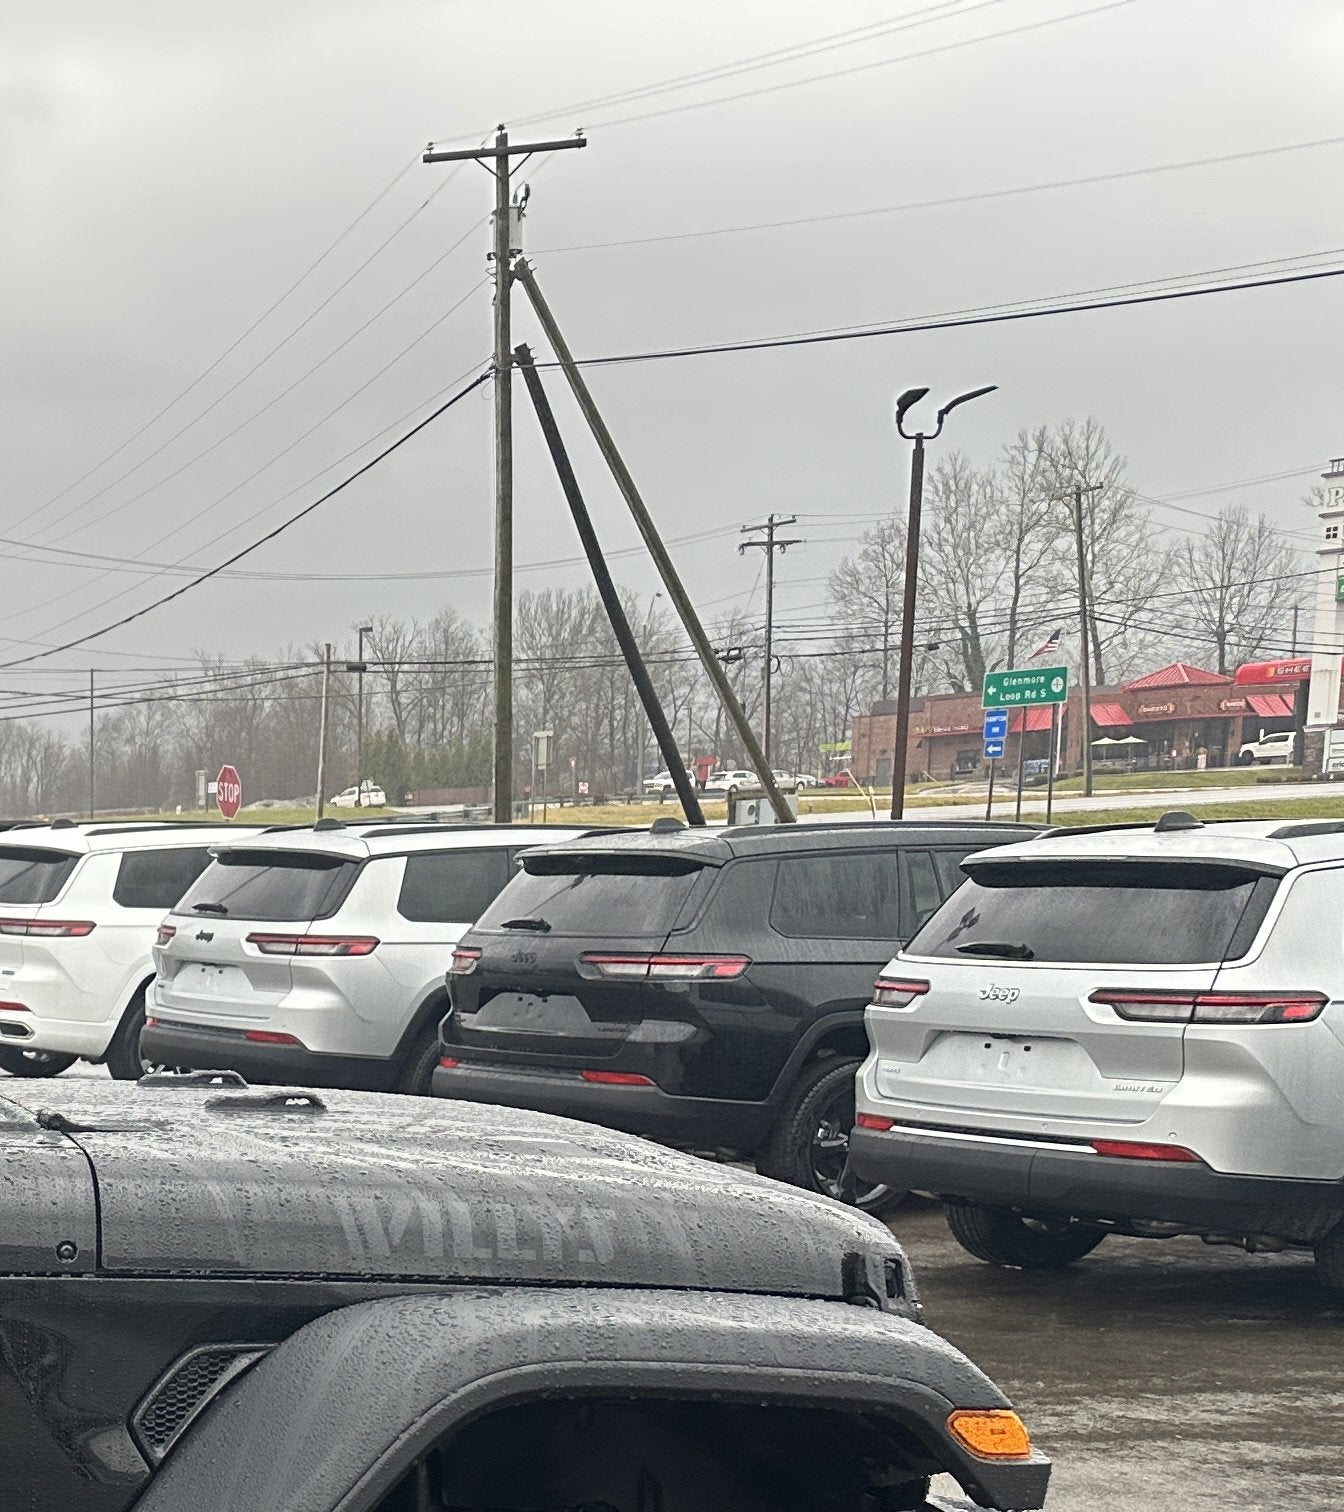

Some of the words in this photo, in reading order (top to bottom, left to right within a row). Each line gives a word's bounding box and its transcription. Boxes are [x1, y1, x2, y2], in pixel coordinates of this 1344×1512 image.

[1002, 675, 1046, 687] Glenmore
[999, 691, 1021, 701] Loop
[1024, 689, 1037, 699] Rd
[1040, 688, 1047, 698] S
[218, 782, 240, 804] STOP
[979, 983, 1021, 1004] Jeep
[338, 1195, 616, 1264] WILLYS
